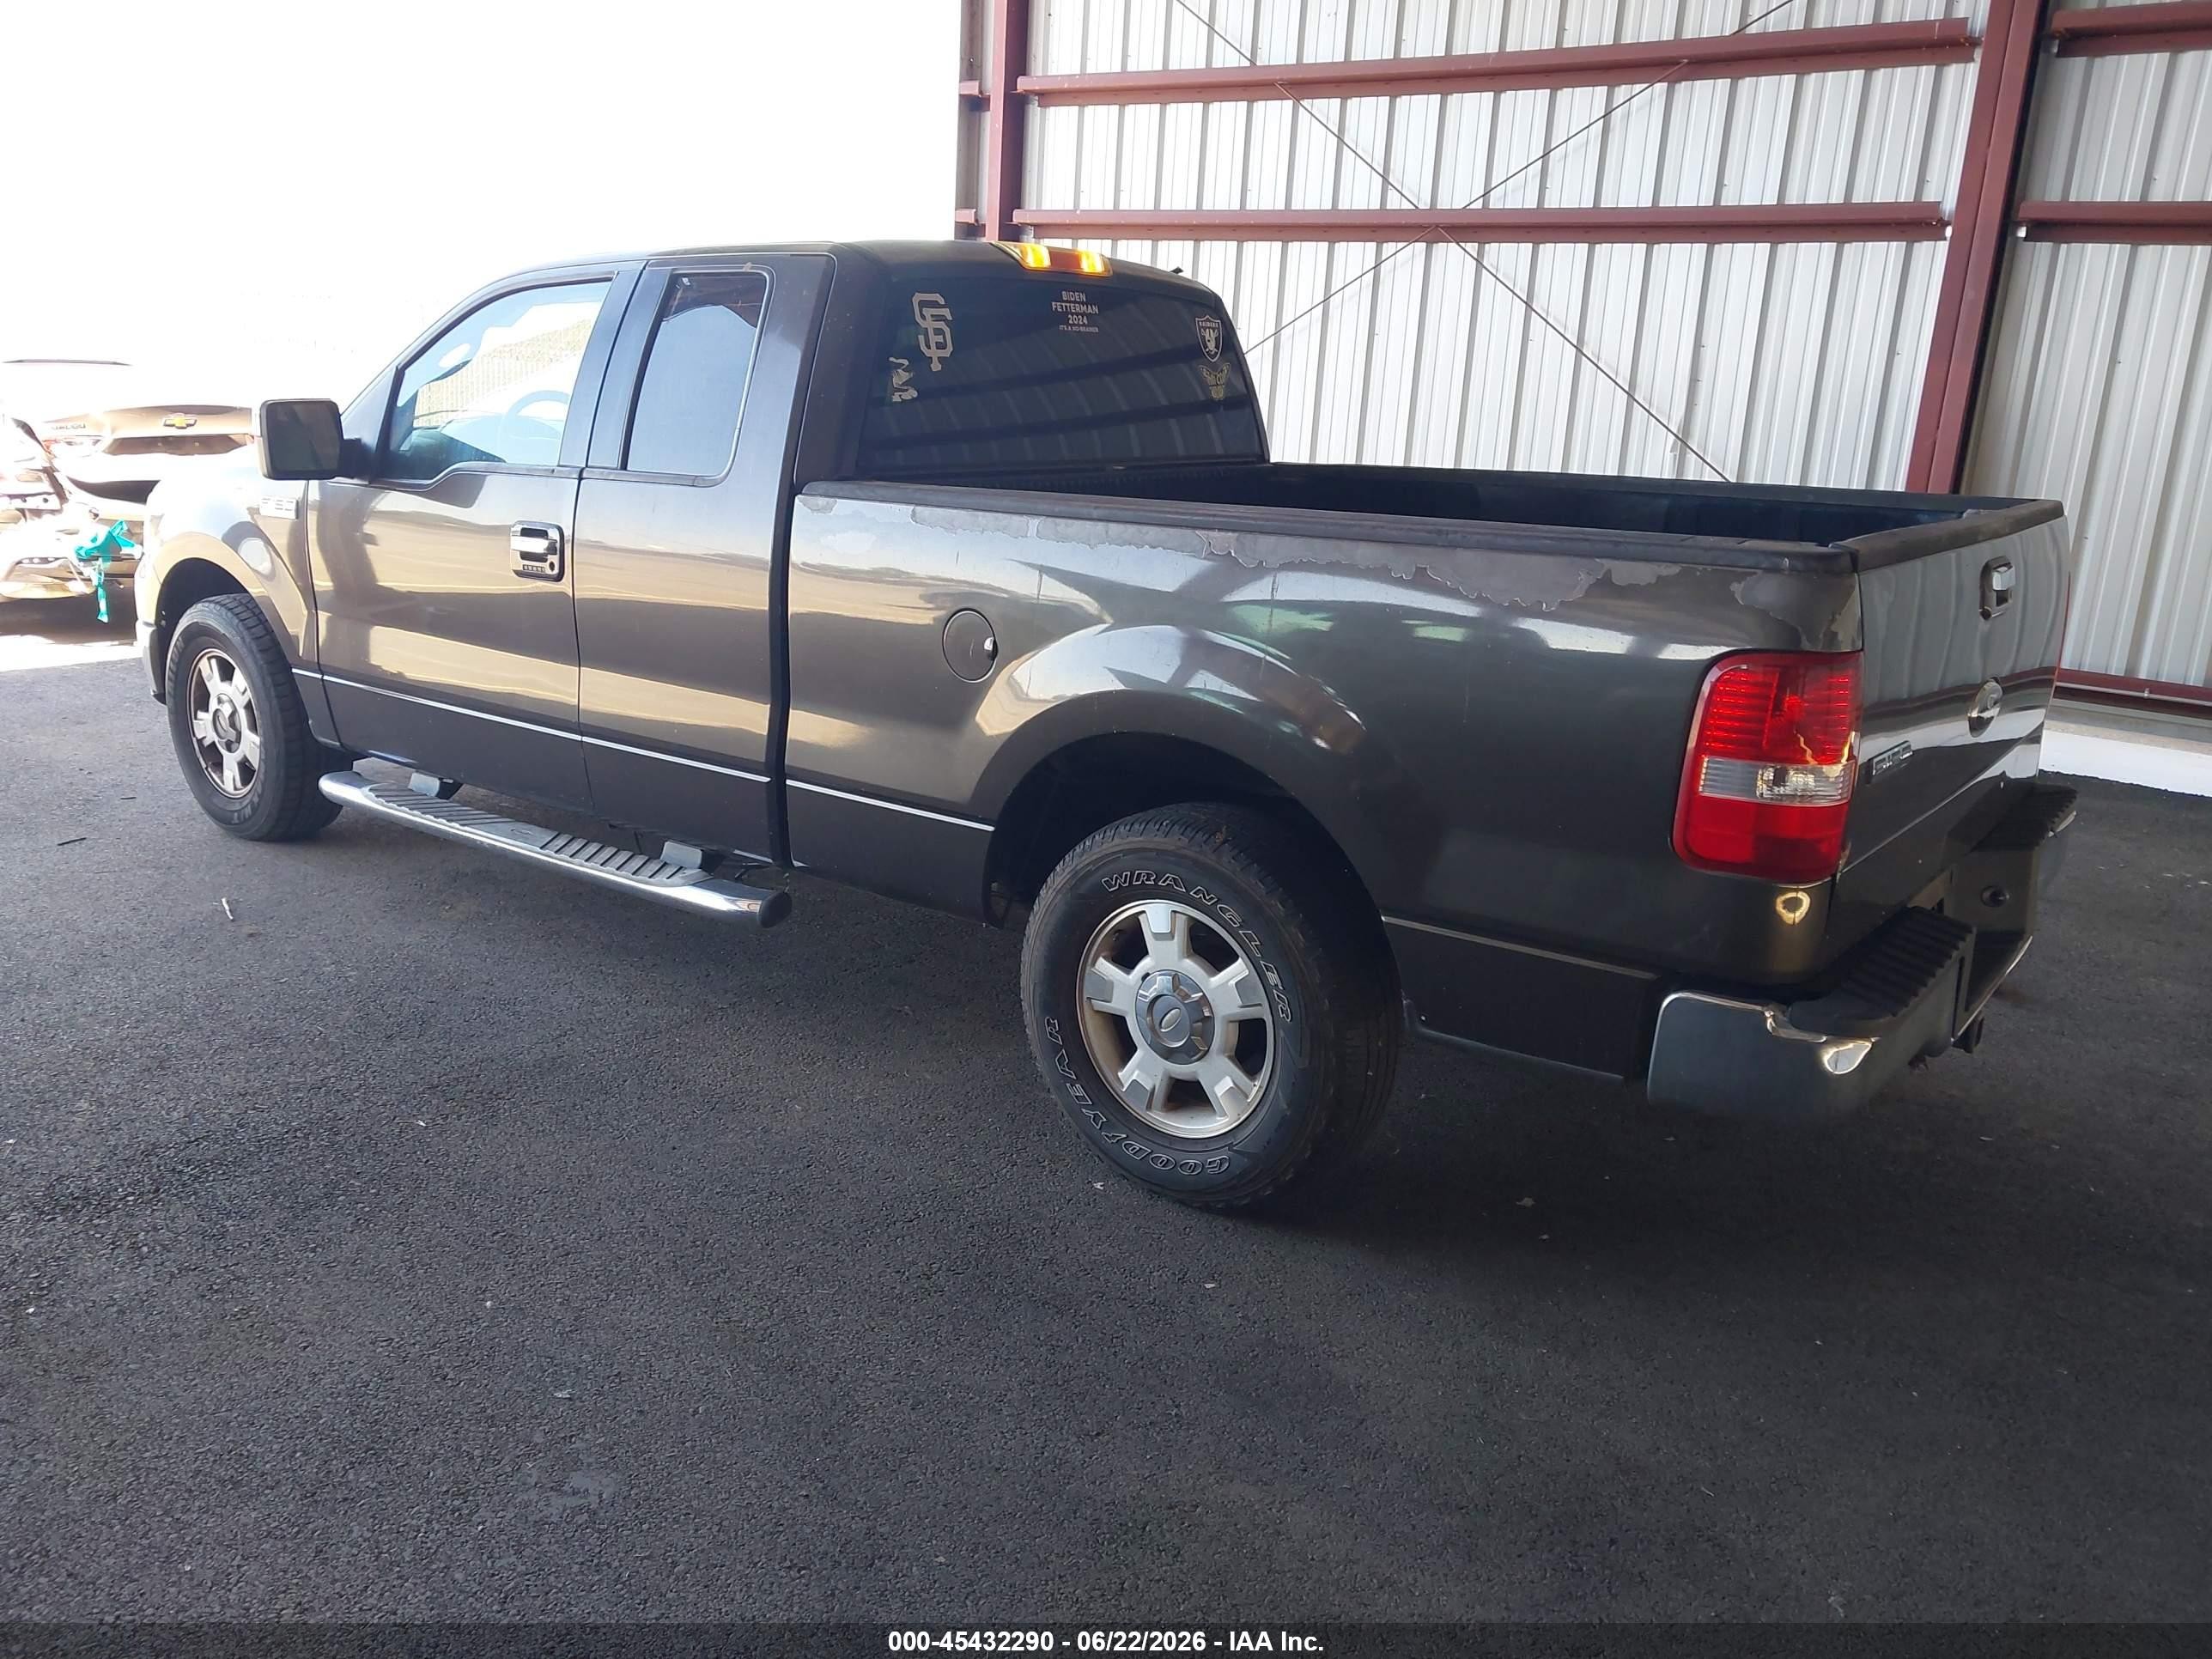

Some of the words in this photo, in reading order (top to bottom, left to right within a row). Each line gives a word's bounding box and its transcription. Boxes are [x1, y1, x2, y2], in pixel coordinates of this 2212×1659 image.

[1061, 290, 1086, 302] BIDEN
[1051, 301, 1099, 314] FETTERMAN
[1067, 314, 1088, 325] 2024
[1102, 870, 1292, 1024] WRANGLER
[1045, 1016, 1230, 1175] GOODYEAR
